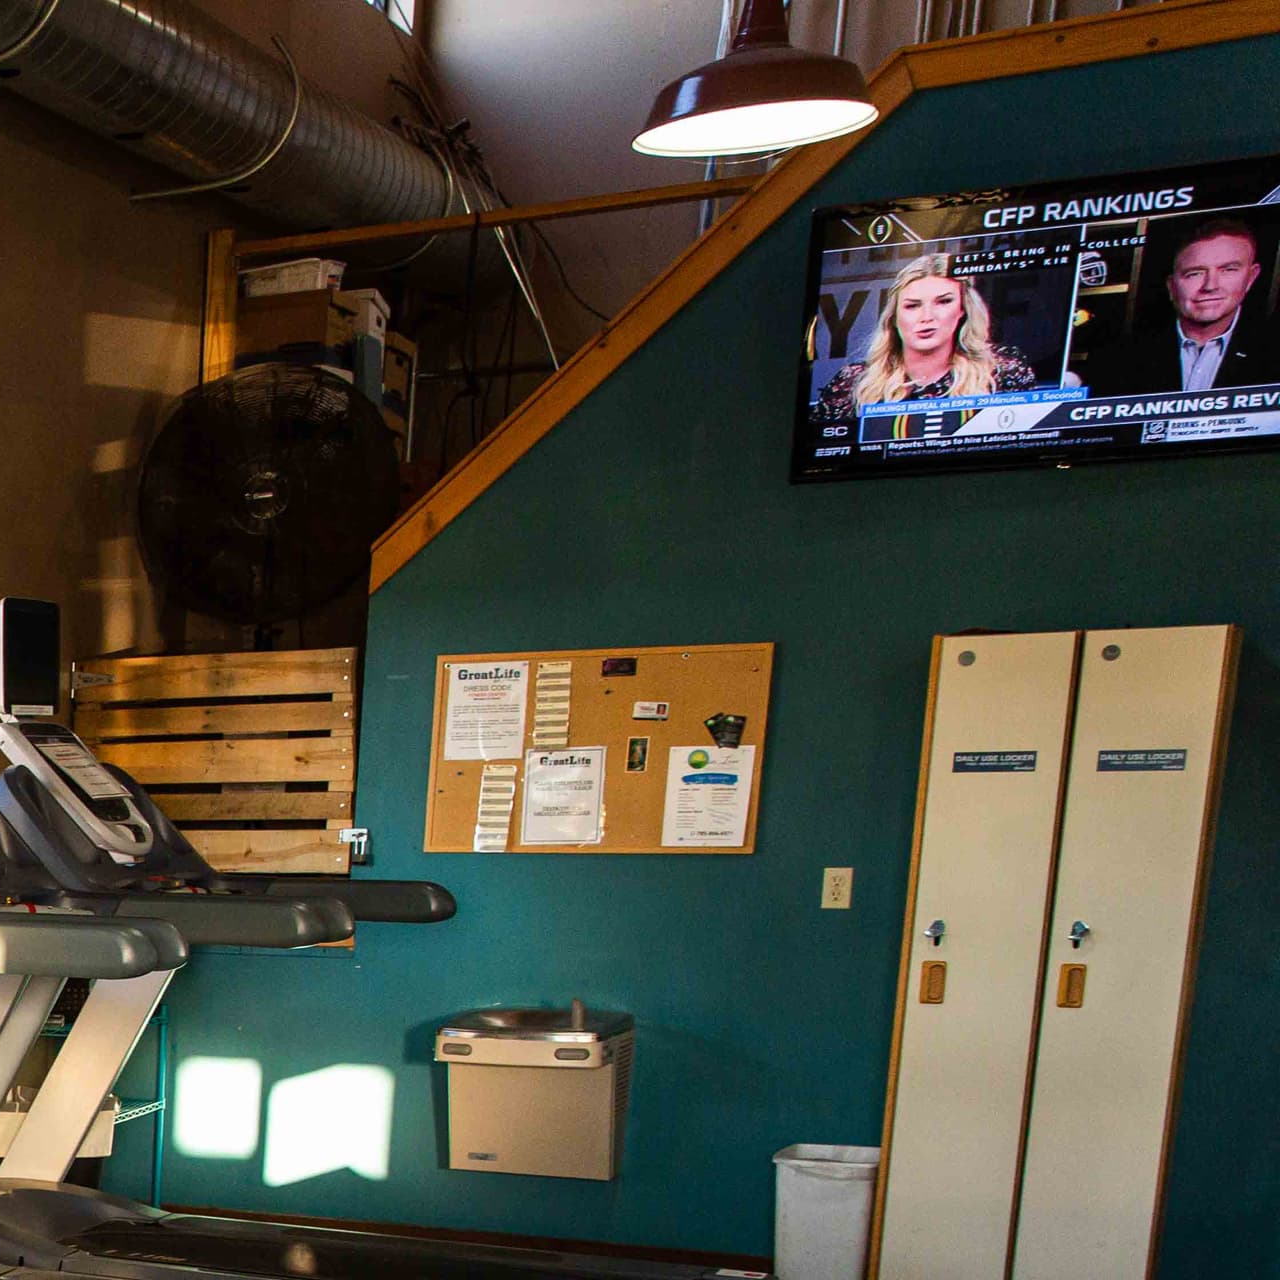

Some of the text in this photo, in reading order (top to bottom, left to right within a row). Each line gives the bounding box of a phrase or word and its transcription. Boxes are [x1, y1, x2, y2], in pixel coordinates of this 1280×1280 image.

[983, 186, 1195, 229] CFP RANKINGS
[955, 251, 995, 264] LET'S
[1004, 246, 1046, 258] BRING
[1055, 243, 1072, 253] IN
[1042, 390, 1083, 401] Seconds
[1070, 391, 1280, 422] CFP RANKINGS REV
[822, 426, 849, 438] SC
[815, 446, 852, 457] ESPN
[458, 667, 521, 681] GreatLife
[540, 755, 592, 767] GreatLife
